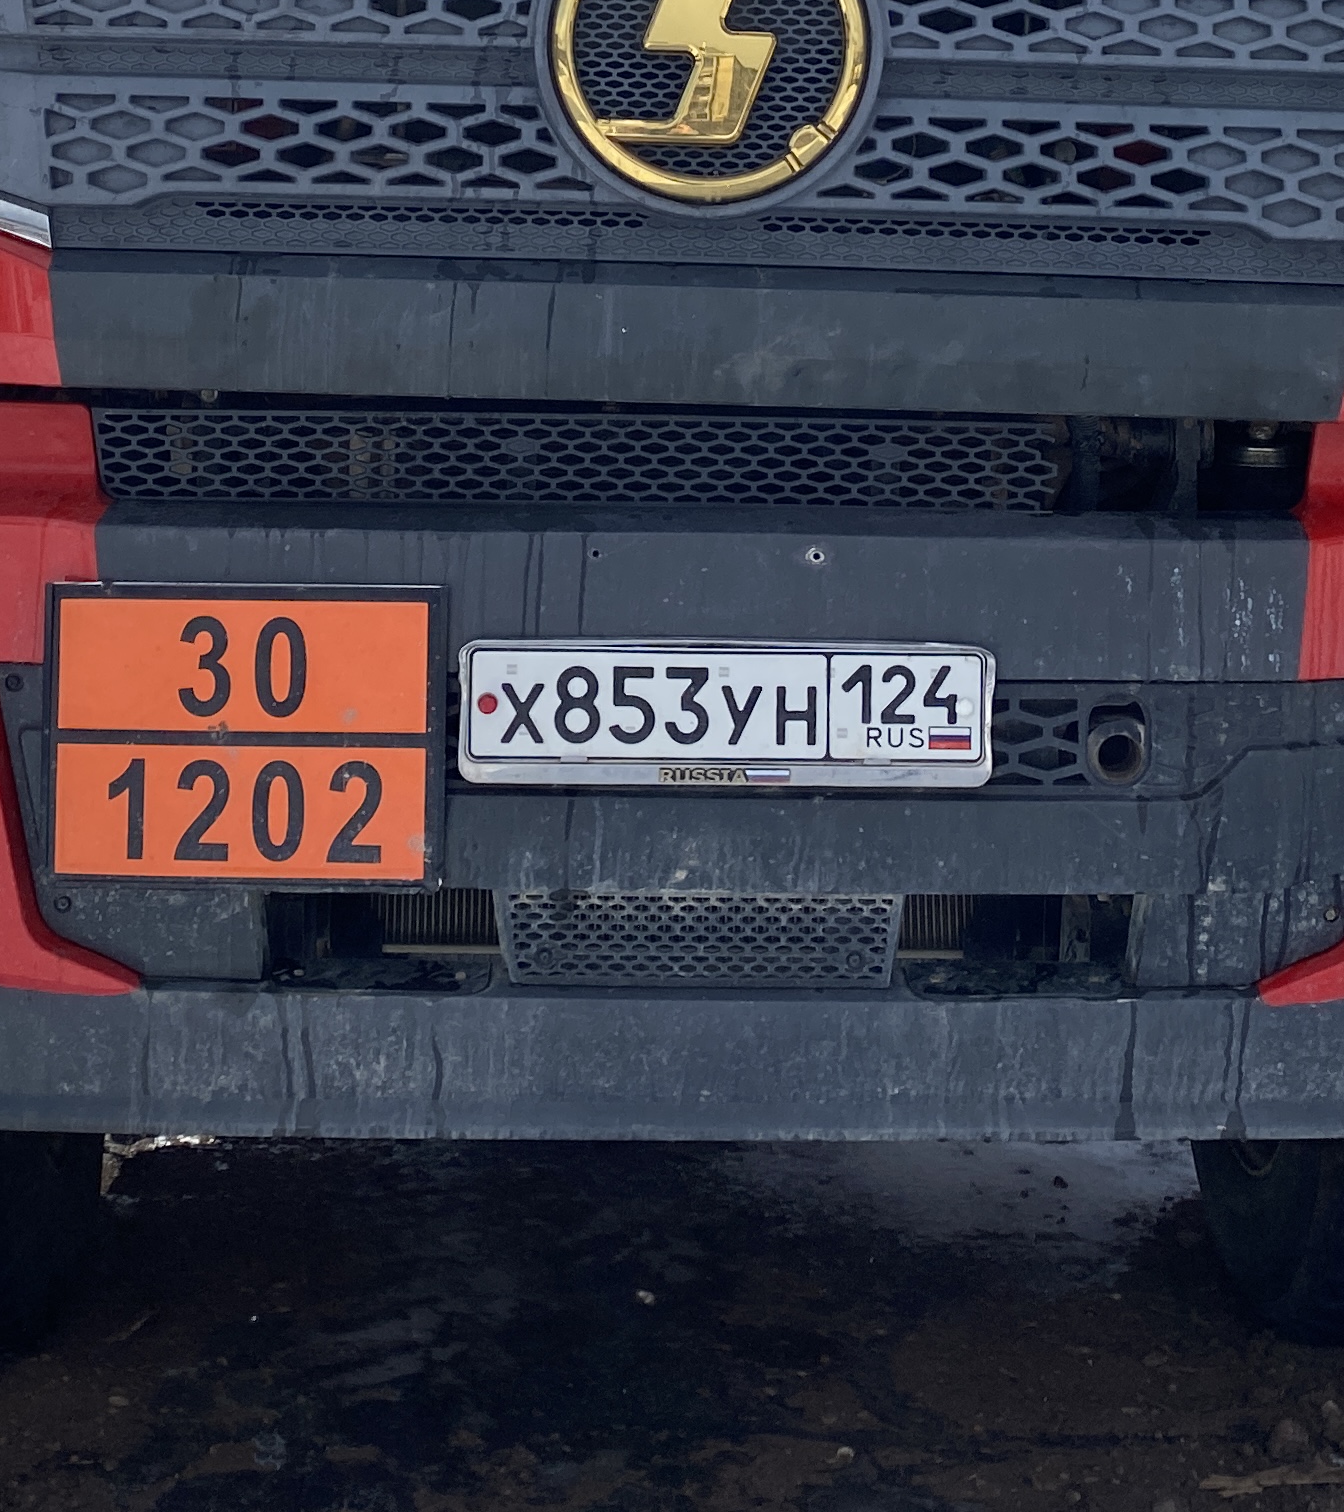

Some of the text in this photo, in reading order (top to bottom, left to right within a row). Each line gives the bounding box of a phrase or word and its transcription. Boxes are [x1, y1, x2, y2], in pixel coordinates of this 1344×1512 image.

[178, 616, 307, 717] 30
[841, 664, 958, 725] 124
[866, 726, 925, 749] RUS
[659, 767, 748, 783] RUSSIA
[108, 757, 383, 863] 1202
